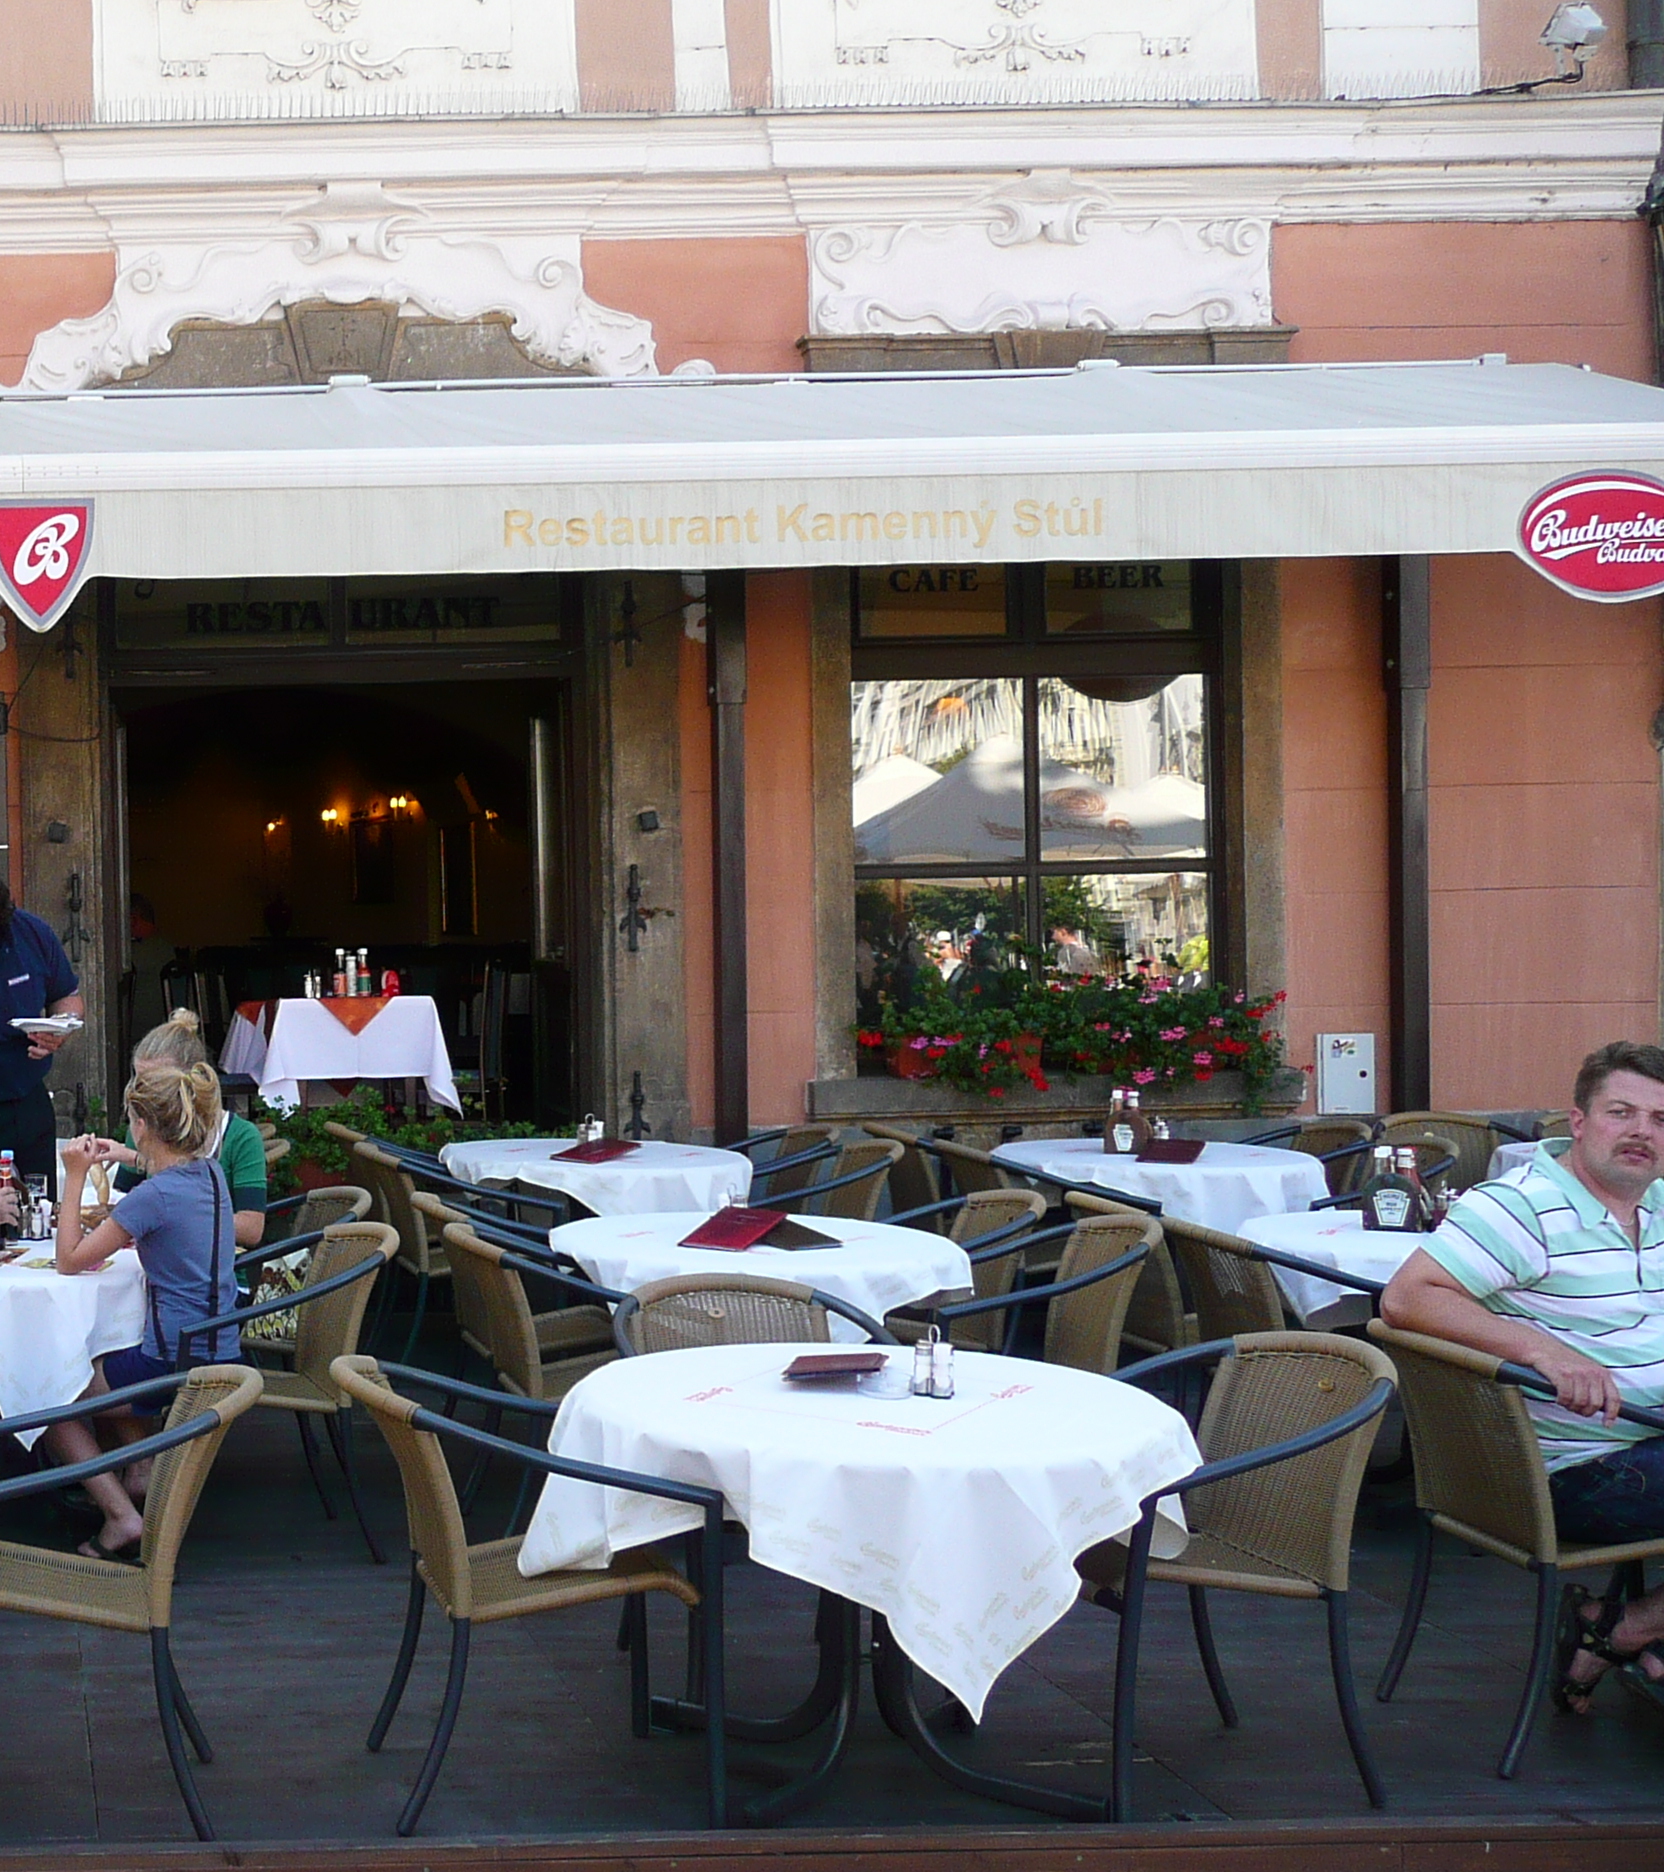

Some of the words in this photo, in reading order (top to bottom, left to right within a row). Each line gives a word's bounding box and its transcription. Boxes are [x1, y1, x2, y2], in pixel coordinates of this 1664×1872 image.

[503, 507, 760, 547] Restaurant
[776, 500, 997, 549] Kamenný
[1012, 497, 1105, 537] Stůl
[889, 569, 979, 593] CAFE
[1072, 564, 1164, 590] BEER
